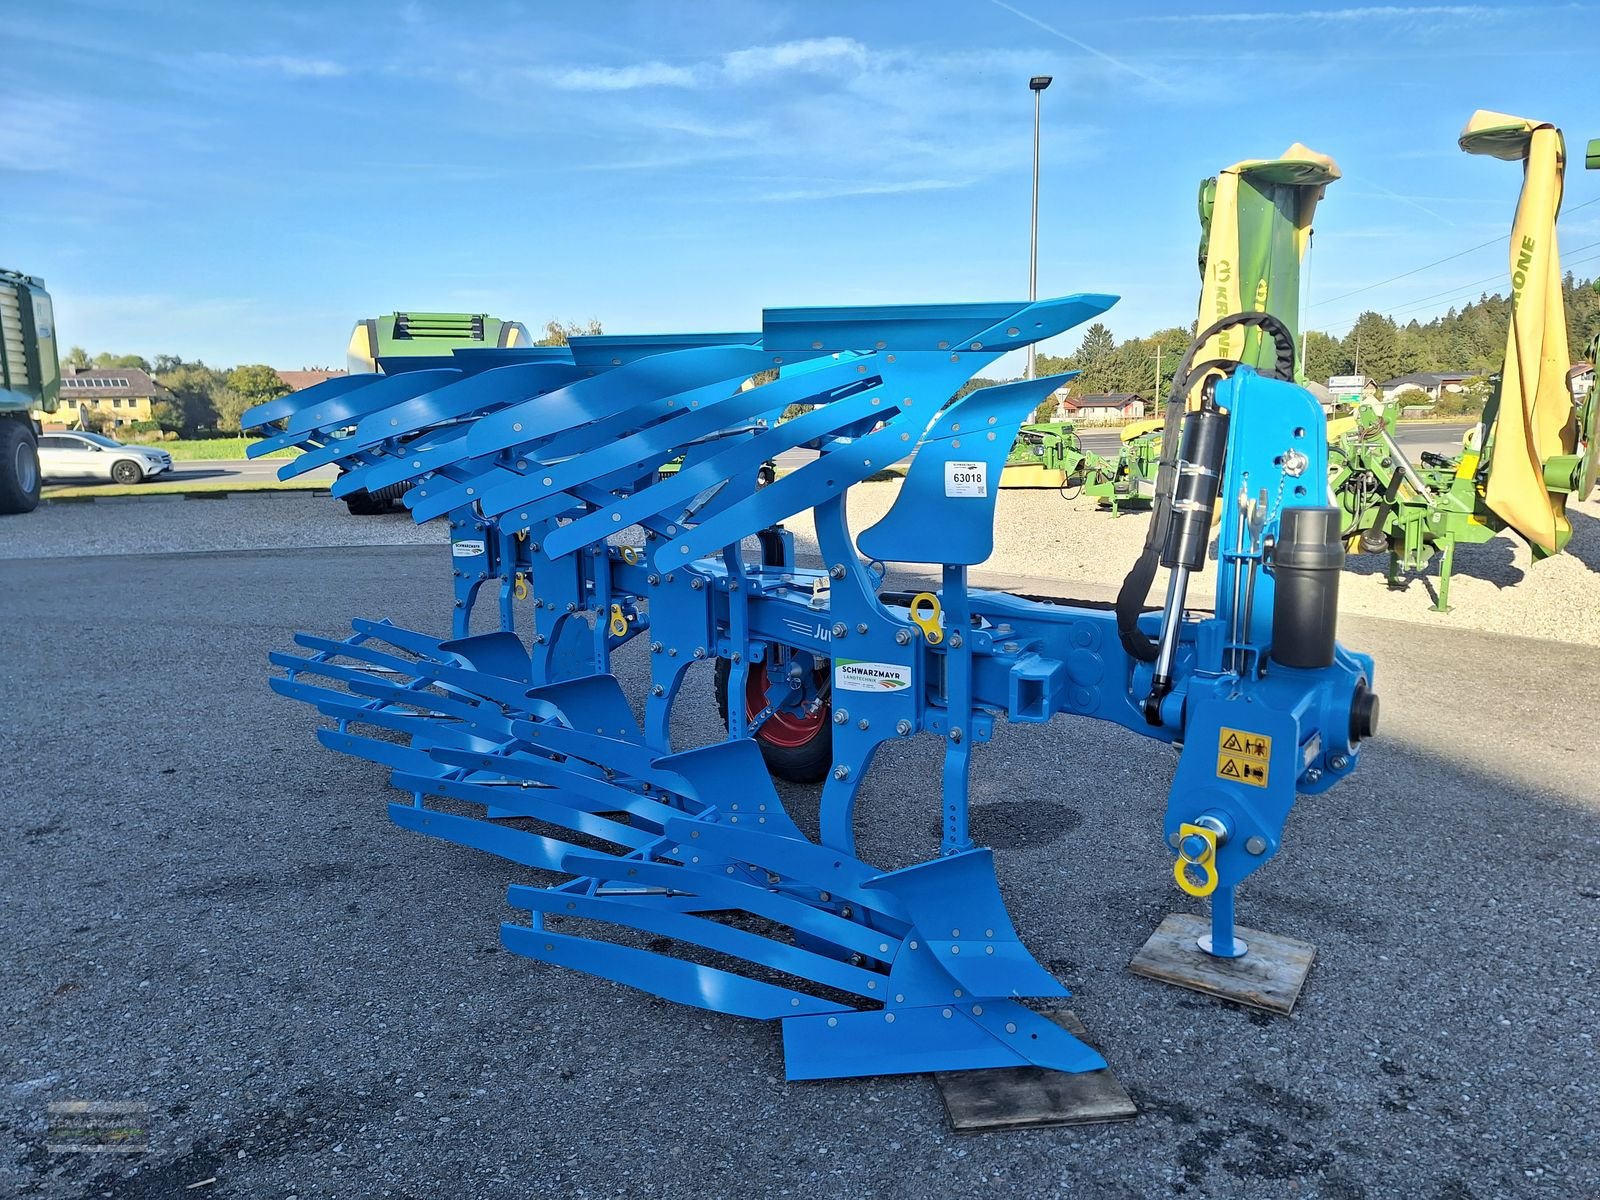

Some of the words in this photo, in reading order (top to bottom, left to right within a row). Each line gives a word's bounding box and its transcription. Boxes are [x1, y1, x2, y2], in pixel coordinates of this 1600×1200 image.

[1216, 286, 1230, 358] KRNE
[953, 473, 982, 483] 63018
[842, 665, 901, 679] SCHWARZMAYR
[843, 674, 877, 683] LANDTECHNIK
